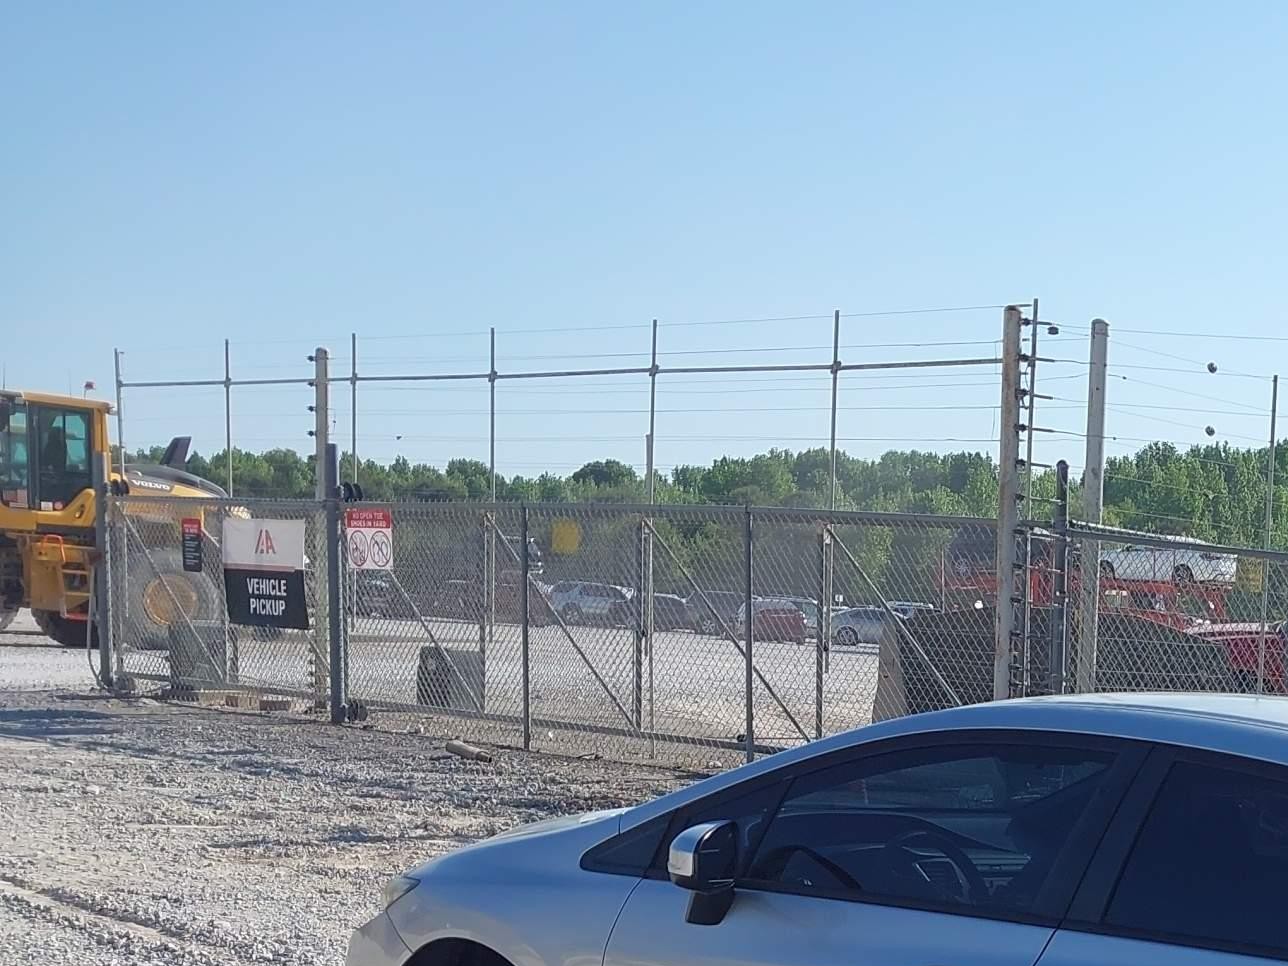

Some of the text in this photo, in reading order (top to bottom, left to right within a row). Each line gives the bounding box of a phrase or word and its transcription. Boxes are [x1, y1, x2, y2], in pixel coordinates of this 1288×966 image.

[131, 480, 170, 491] VOLVO
[246, 577, 287, 597] VEHICLE
[249, 597, 286, 616] PICKUP
